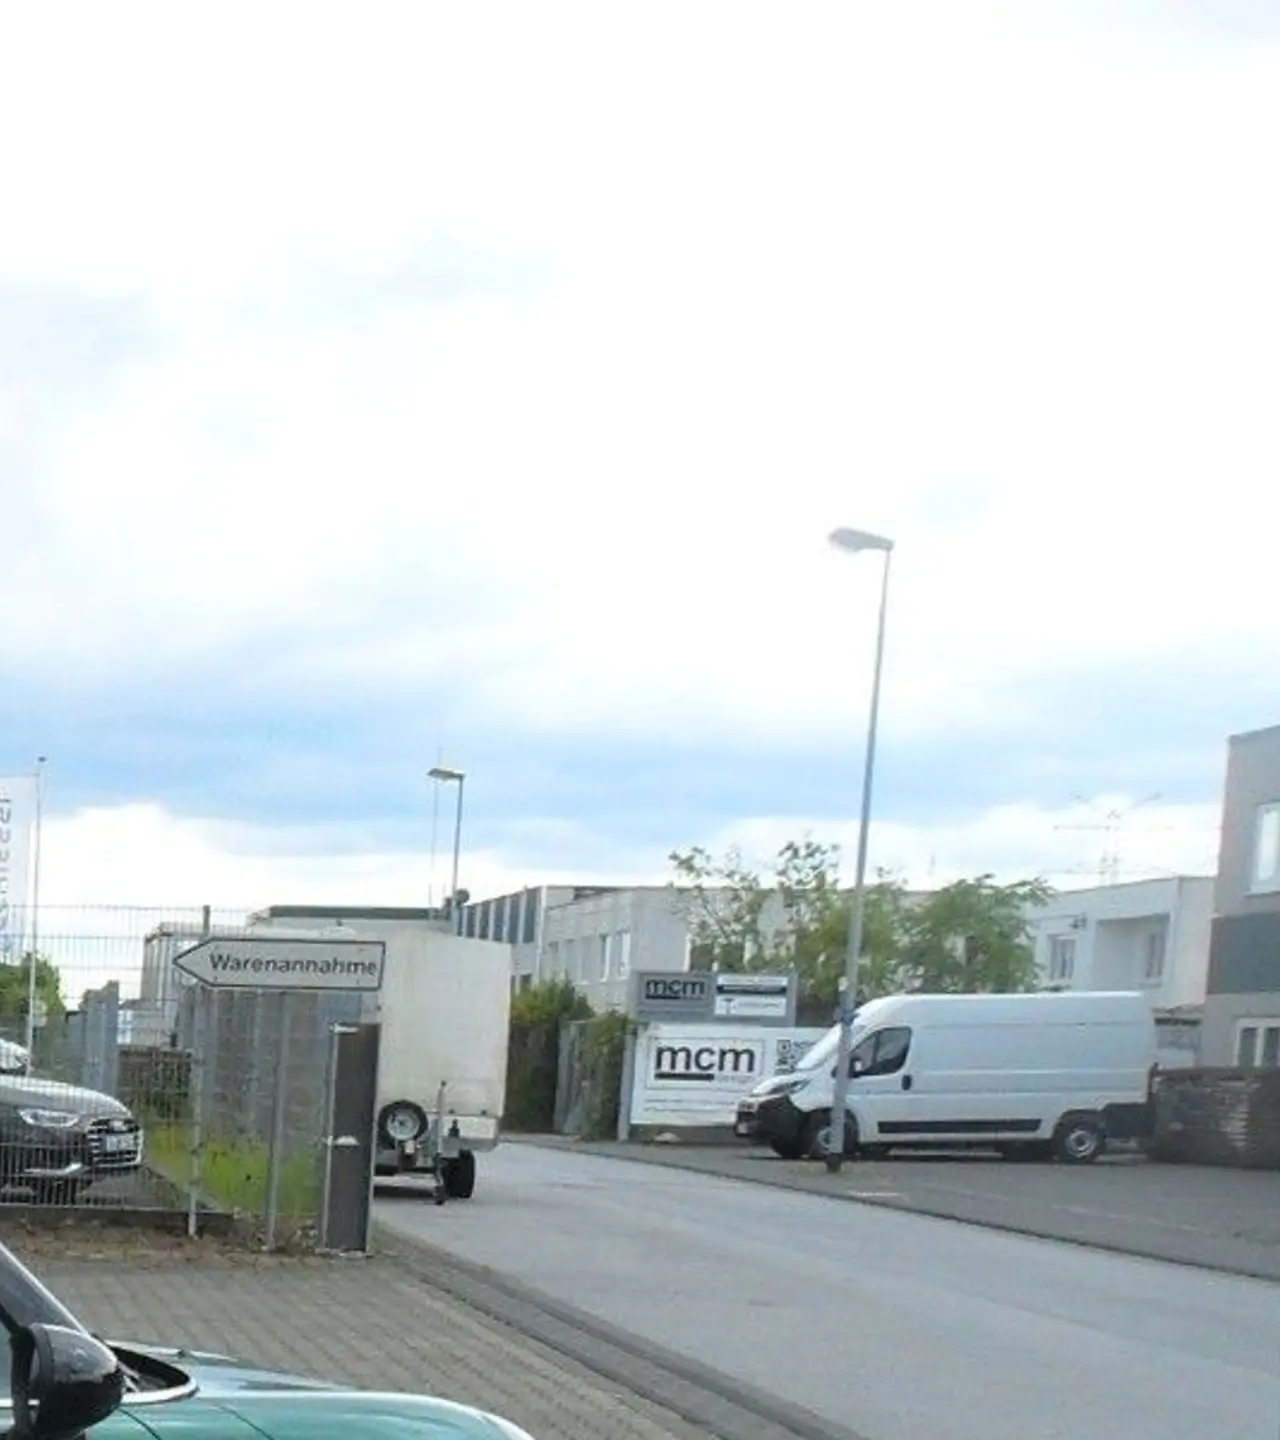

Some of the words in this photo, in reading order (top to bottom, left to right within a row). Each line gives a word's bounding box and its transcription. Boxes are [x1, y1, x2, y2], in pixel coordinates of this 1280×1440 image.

[209, 953, 377, 976] Warenannahme
[646, 979, 705, 995] mcm
[656, 1045, 756, 1072] mcm
